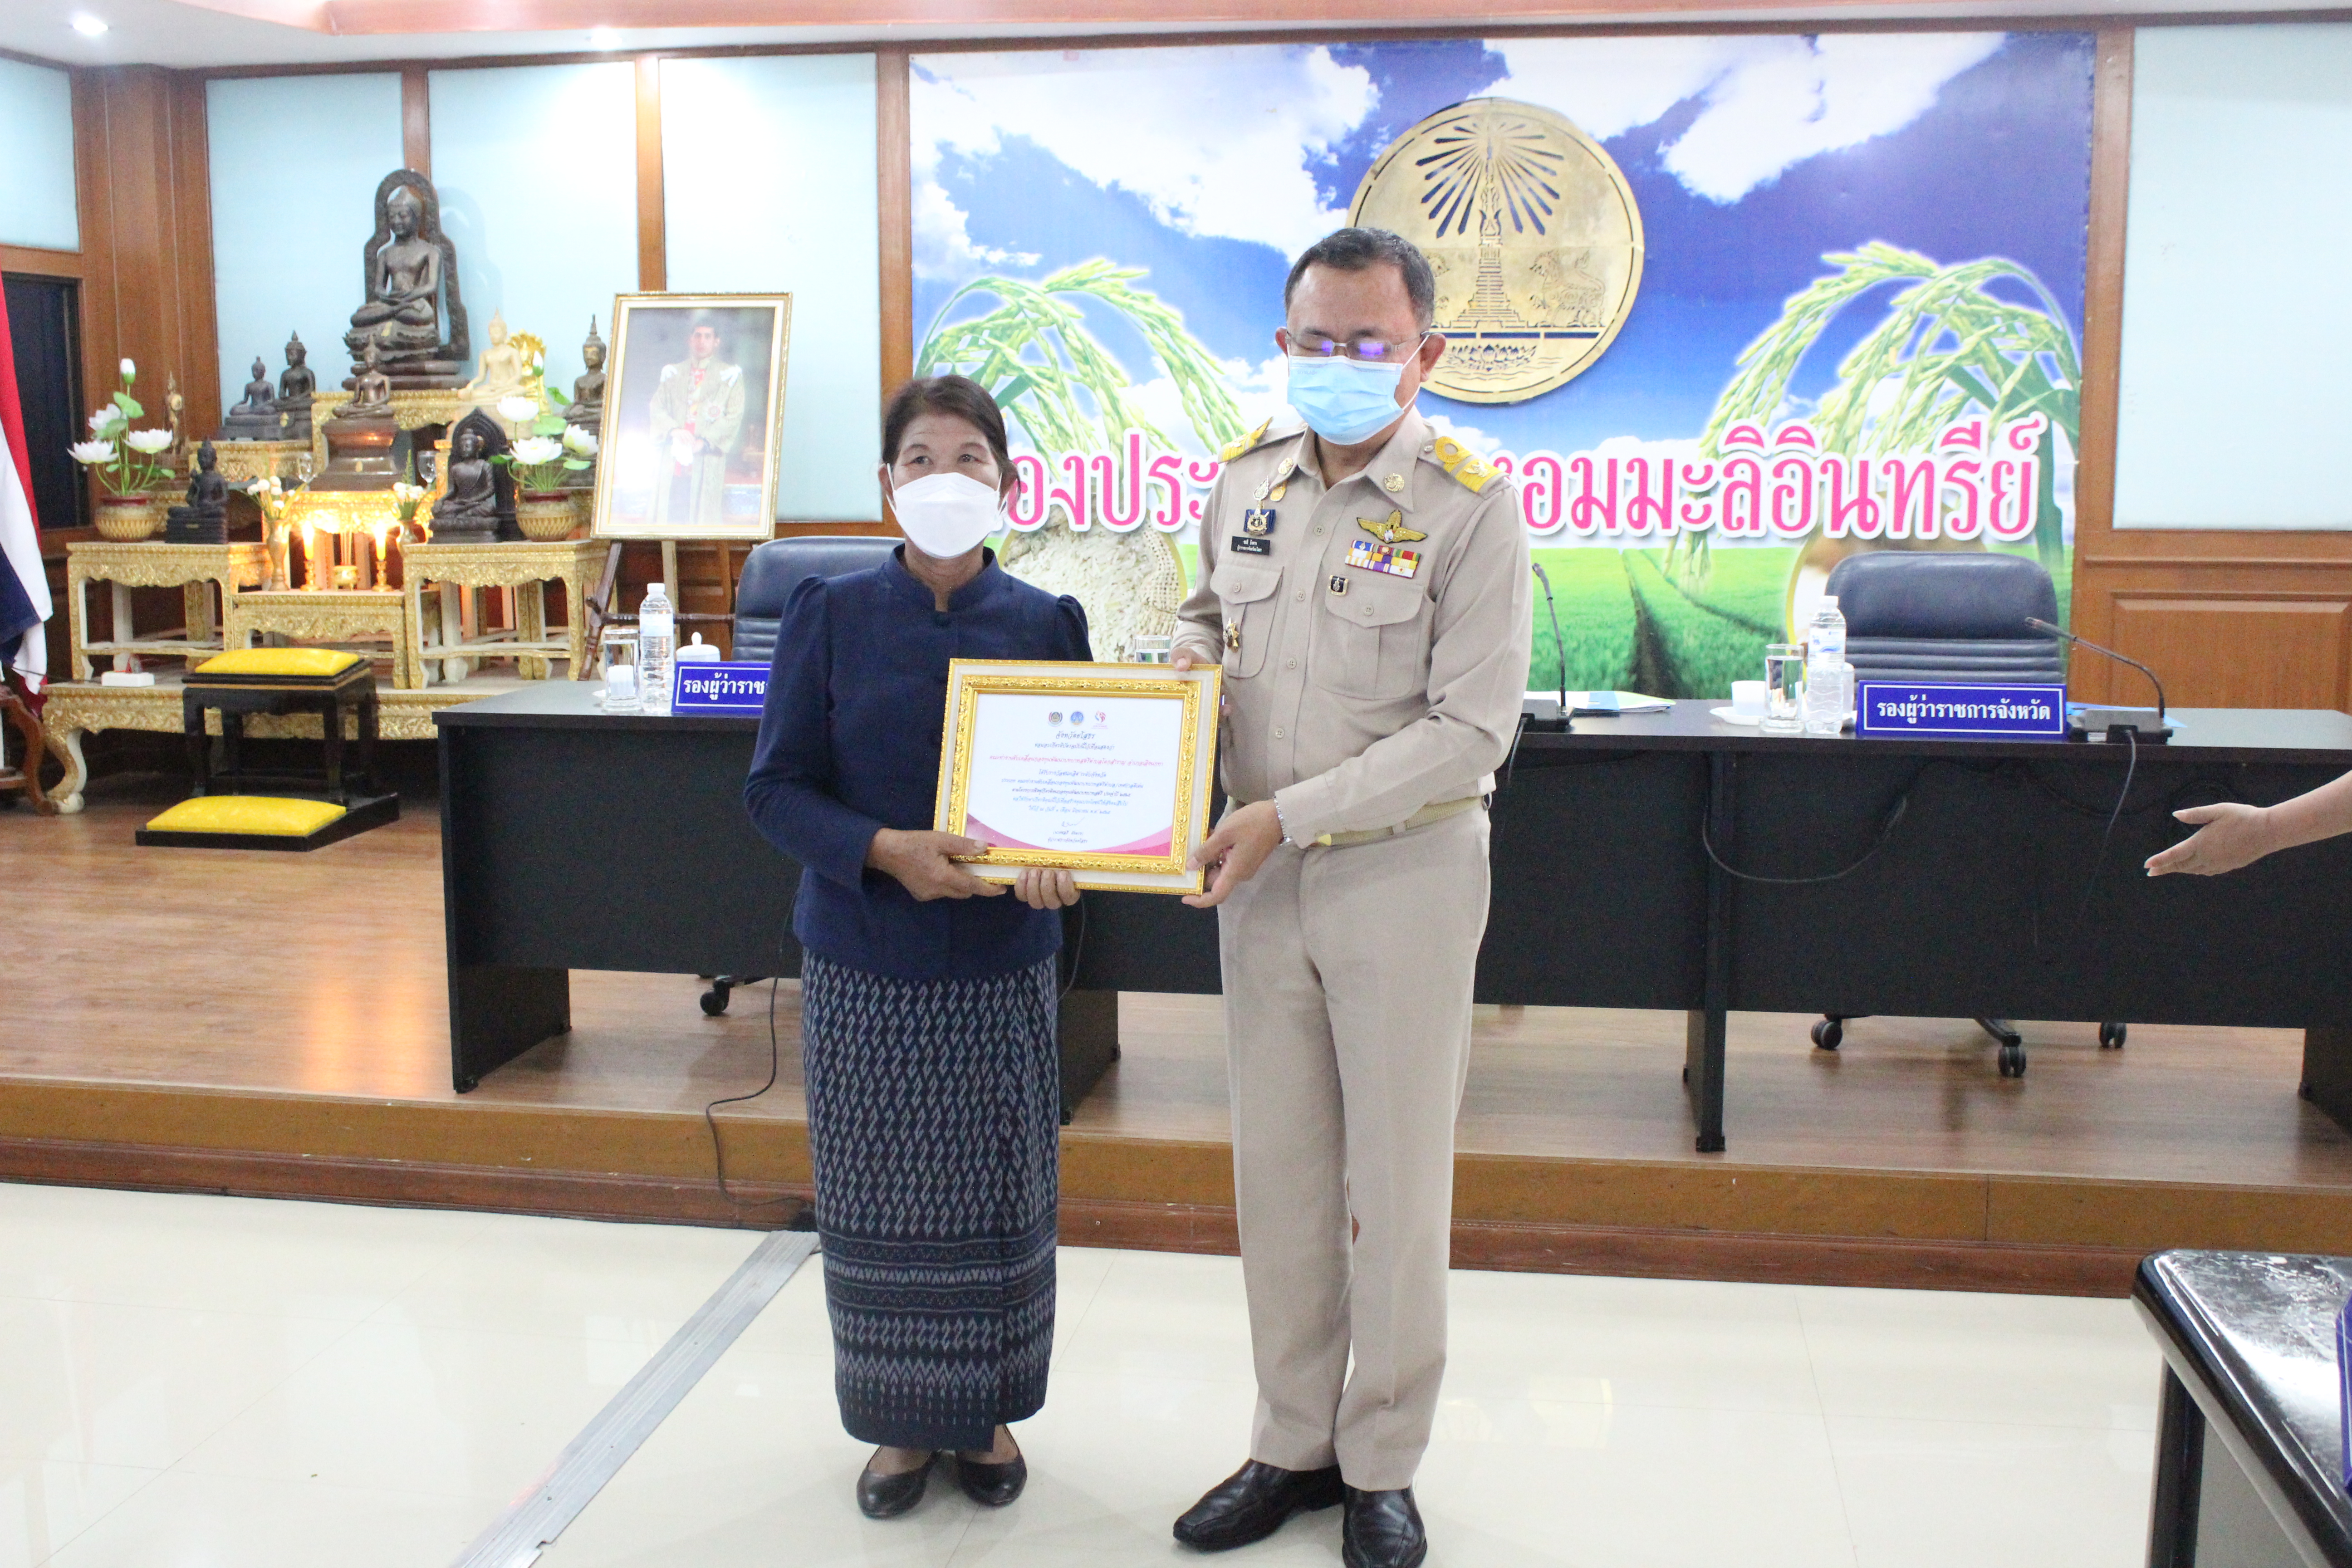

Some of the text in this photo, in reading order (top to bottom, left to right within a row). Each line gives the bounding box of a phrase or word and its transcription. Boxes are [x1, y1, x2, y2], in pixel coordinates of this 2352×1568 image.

[1494, 418, 2040, 535] อมมะลิอินทรีย์
[683, 672, 768, 700] รองผู้ว่าราช
[1877, 694, 2051, 724] รองผู้ว่าราชการจังหวัด
